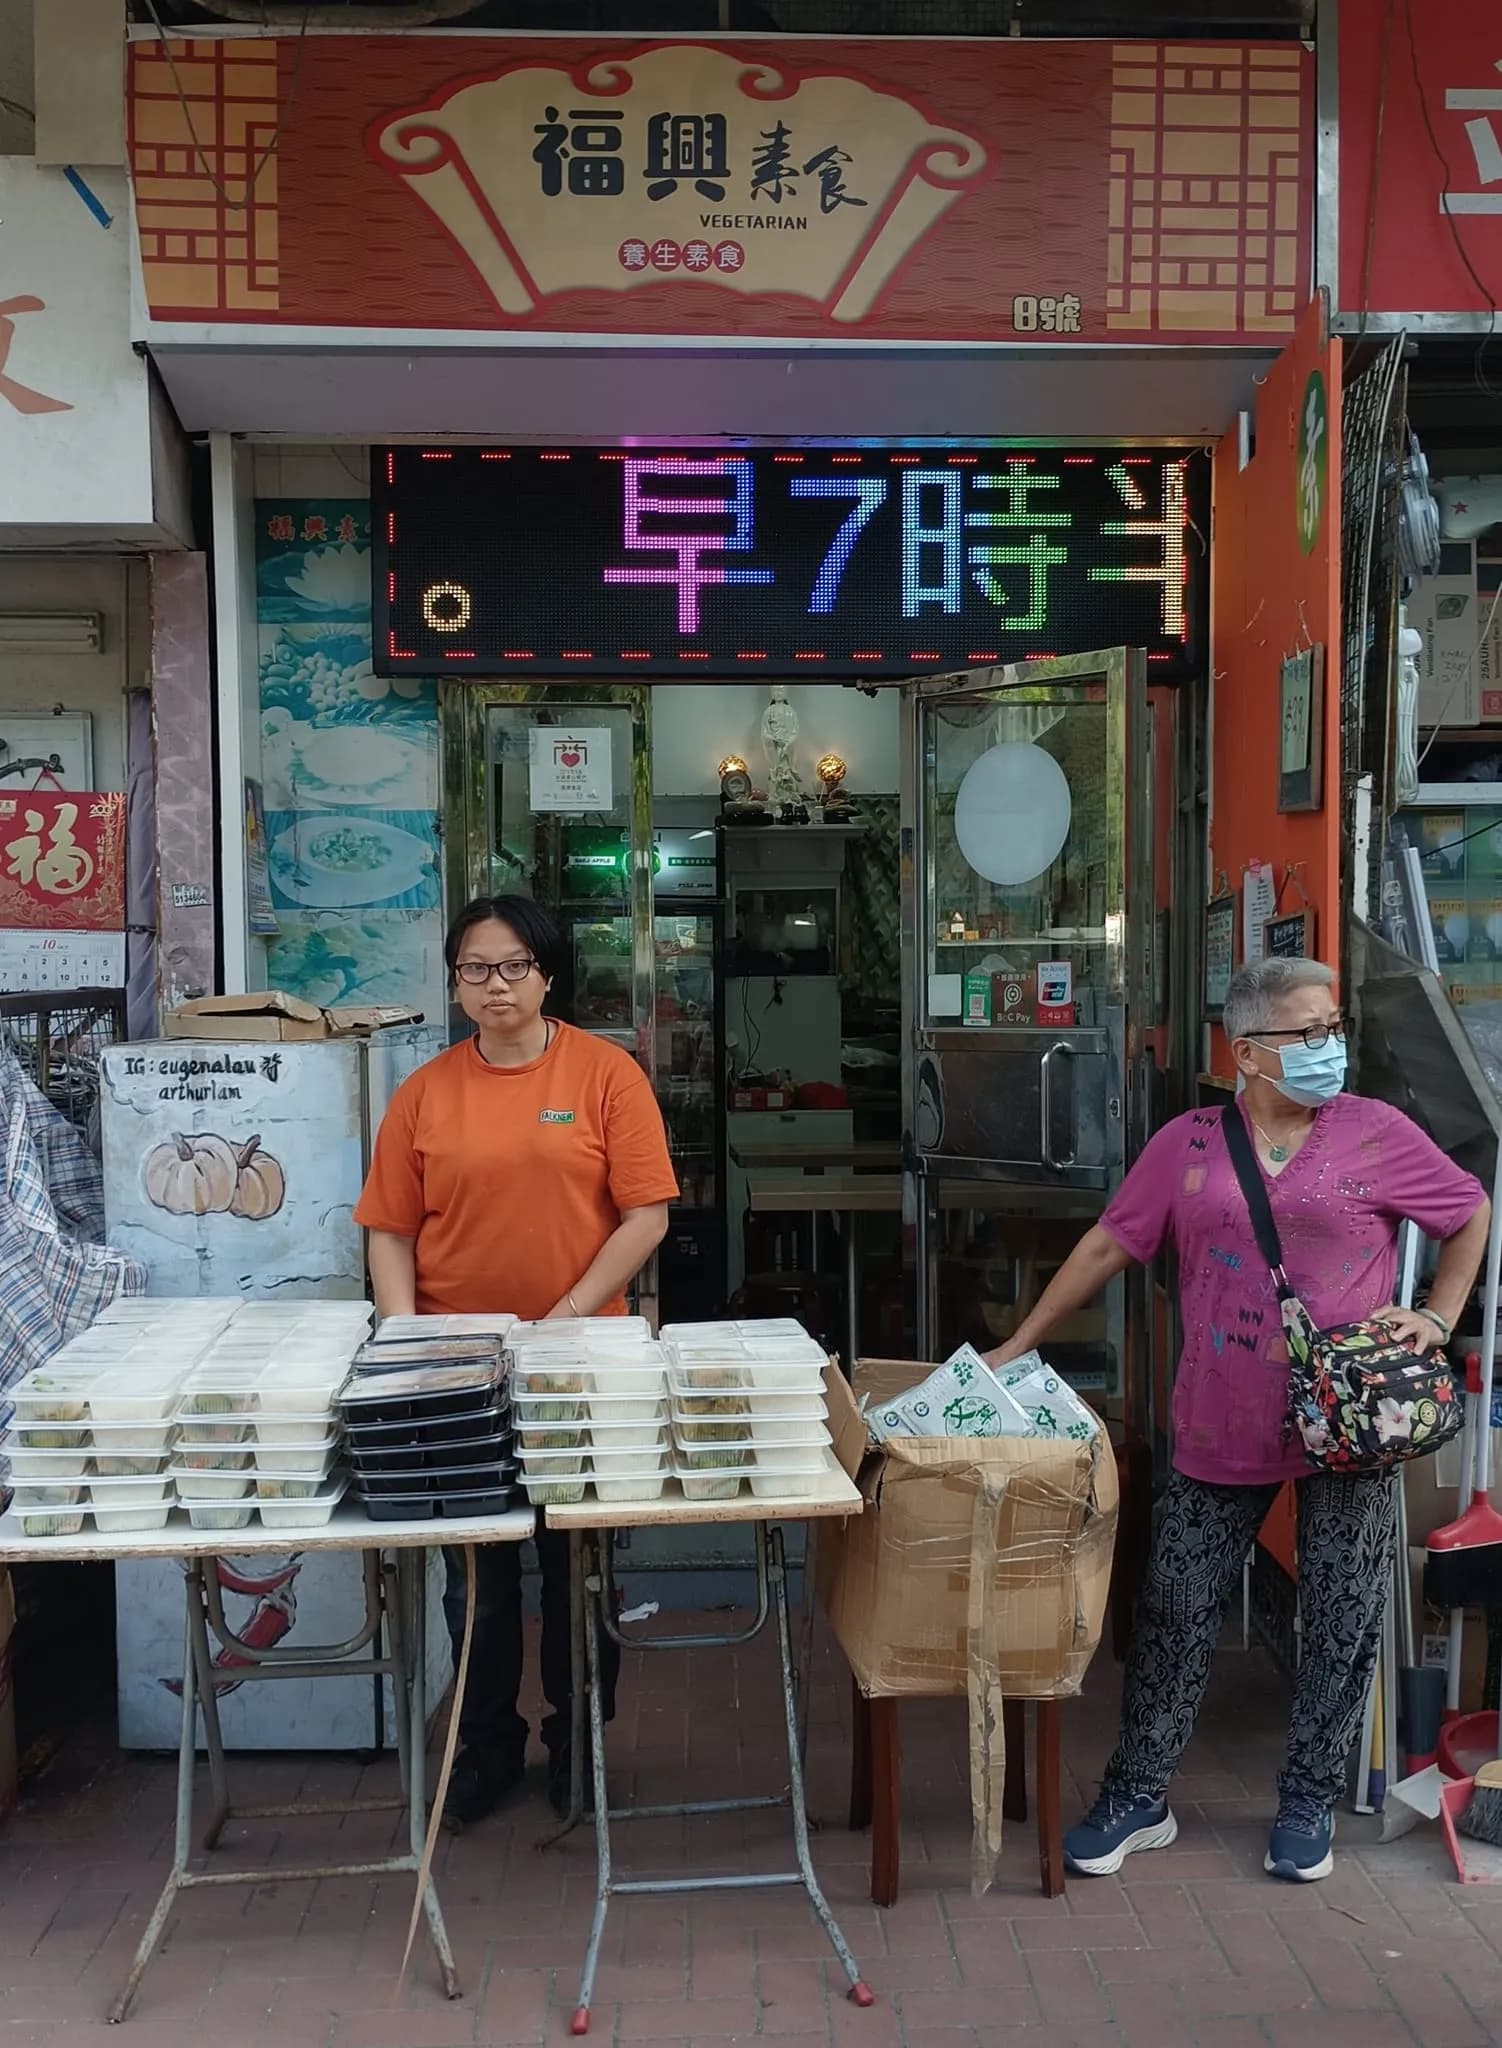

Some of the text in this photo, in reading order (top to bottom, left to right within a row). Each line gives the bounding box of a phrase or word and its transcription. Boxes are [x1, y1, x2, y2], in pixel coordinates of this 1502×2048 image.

[532, 106, 868, 214] 福興素食
[699, 214, 808, 230] VEGETARIAN
[622, 241, 743, 270] 養生素食
[1013, 292, 1082, 333] 8號
[267, 514, 371, 541] 福興素
[5, 803, 93, 895] 福
[42, 939, 57, 950] 10
[61, 958, 68, 966] 3
[100, 974, 111, 982] 12
[159, 1079, 242, 1100] arthurlam
